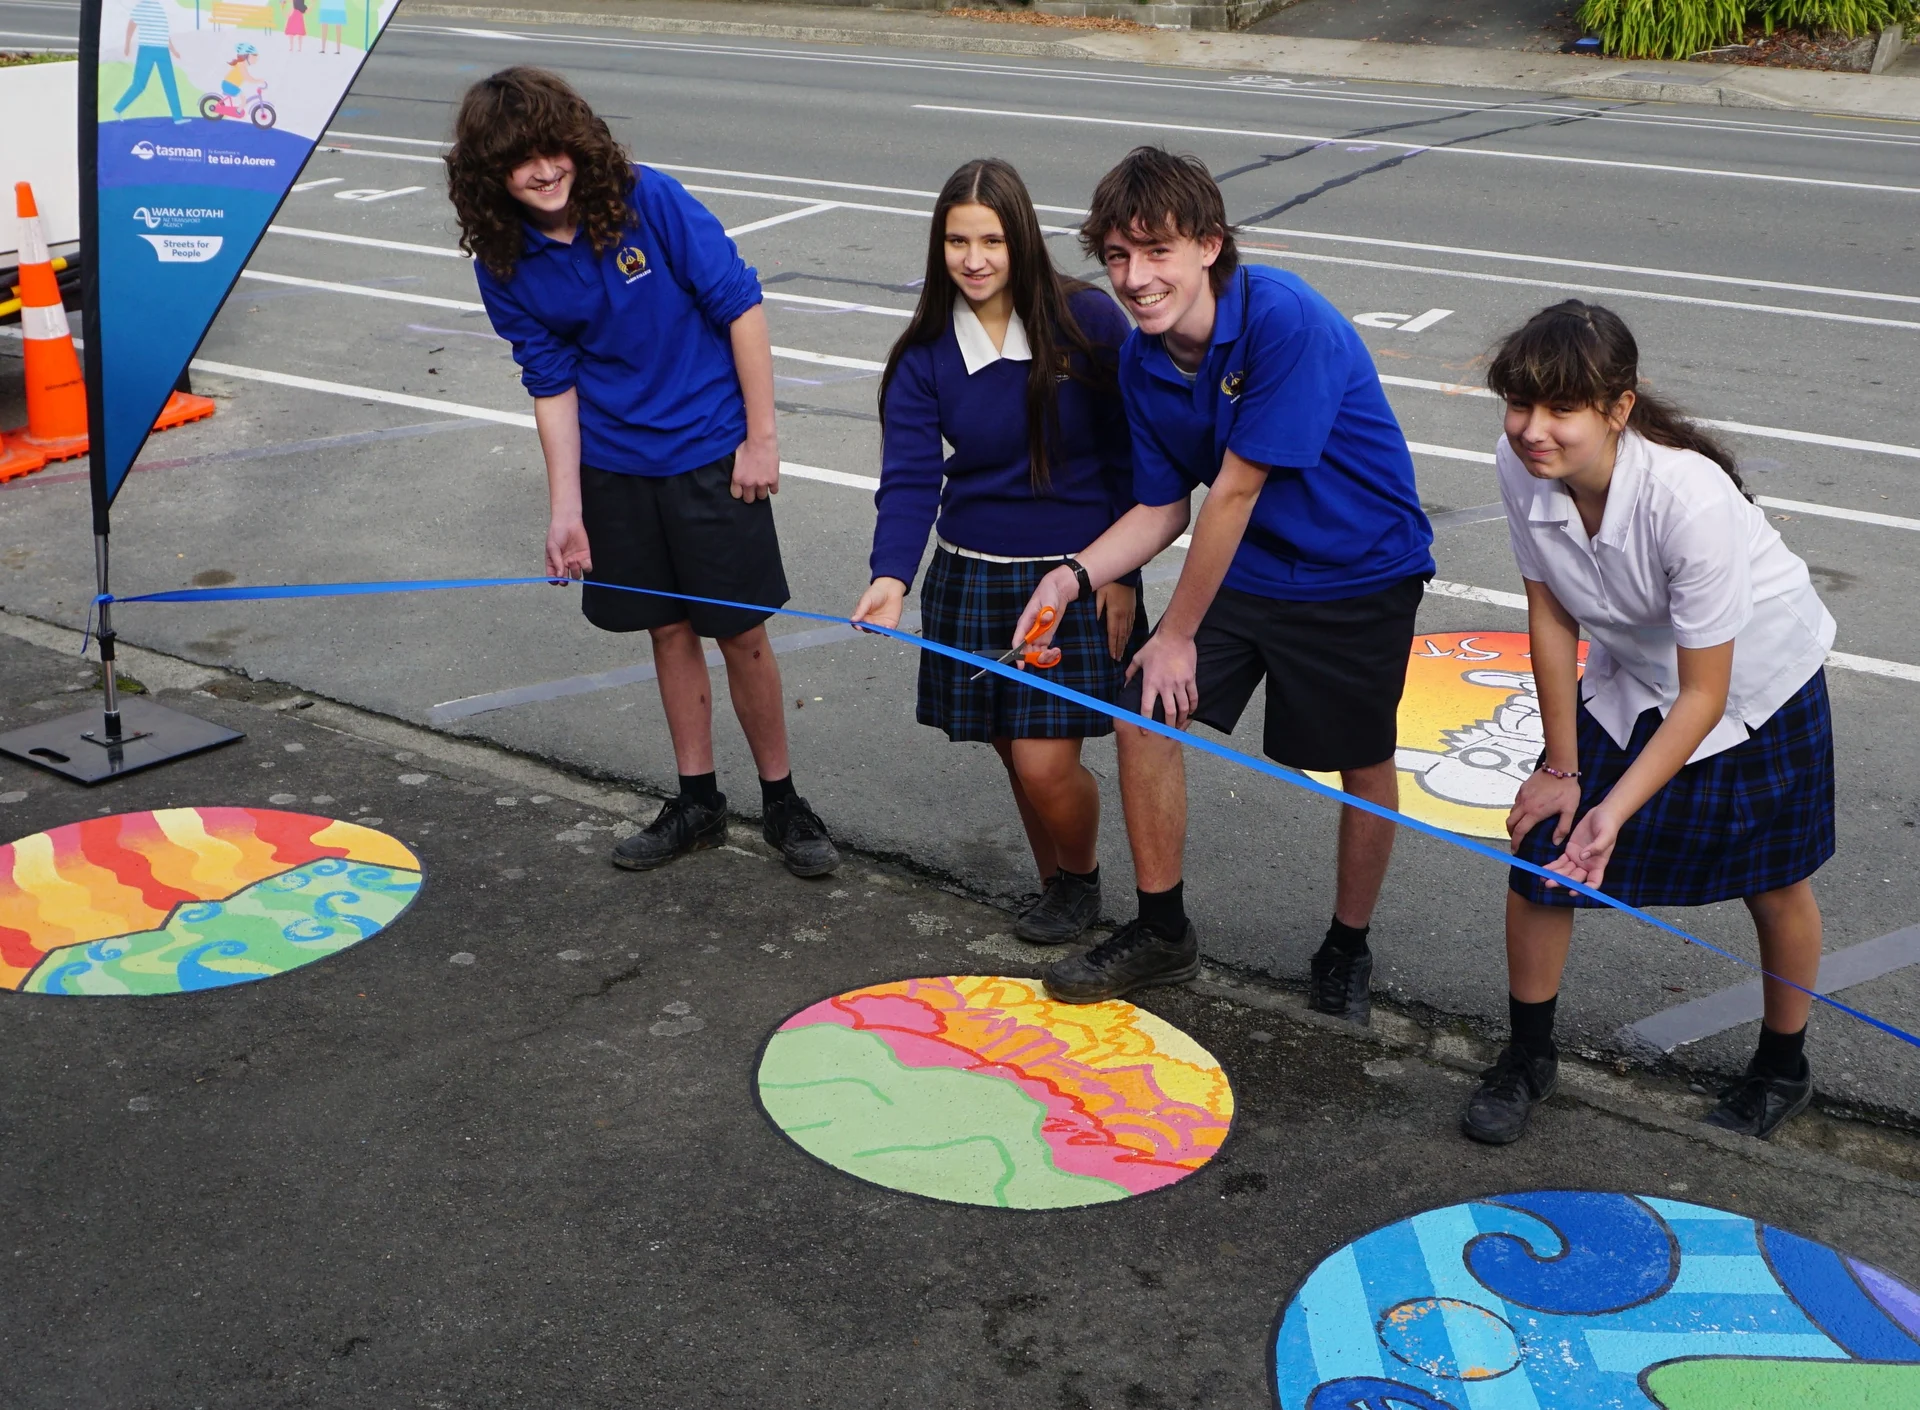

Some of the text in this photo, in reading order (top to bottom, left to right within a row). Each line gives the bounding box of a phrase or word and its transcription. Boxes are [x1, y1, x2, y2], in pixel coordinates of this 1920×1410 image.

[156, 145, 202, 158] tasman
[208, 155, 219, 164] te
[220, 155, 233, 165] tai
[234, 157, 241, 165] o
[242, 156, 276, 167] Aorere
[151, 207, 224, 218] WAKA KOTAHI
[163, 240, 195, 248] Streets
[172, 249, 201, 258] People
